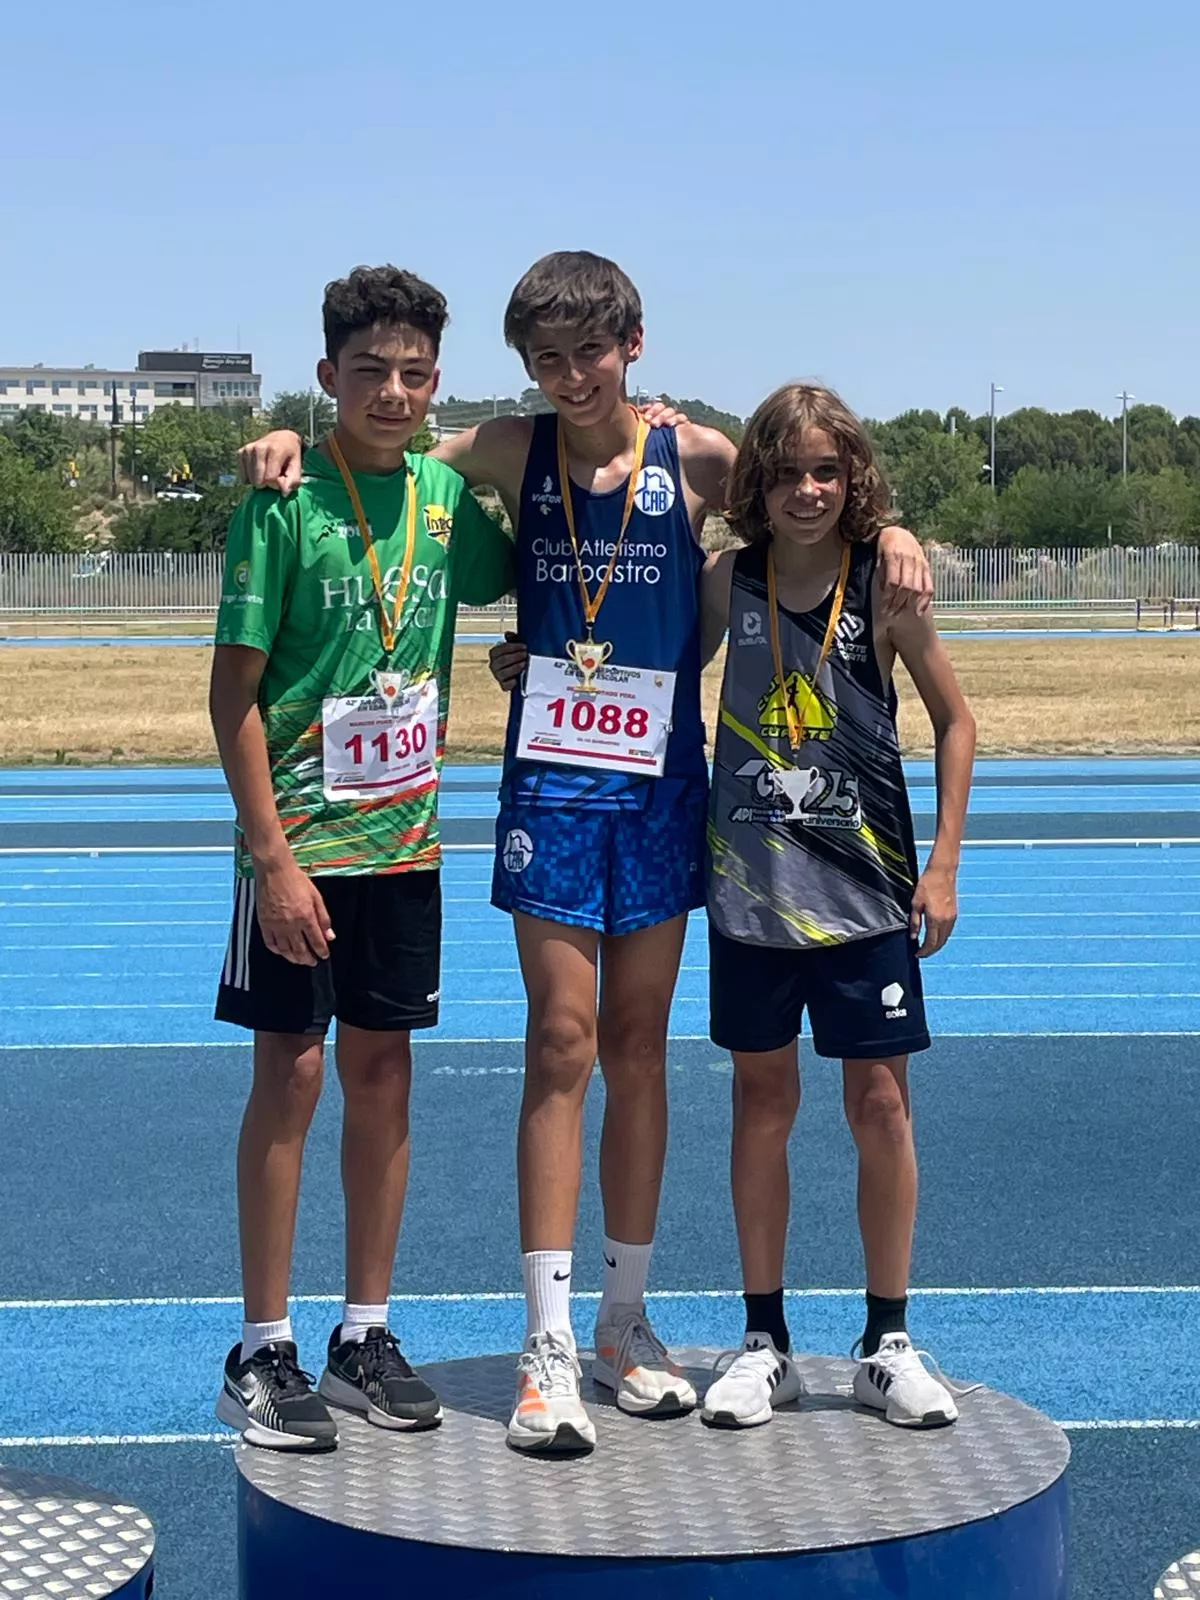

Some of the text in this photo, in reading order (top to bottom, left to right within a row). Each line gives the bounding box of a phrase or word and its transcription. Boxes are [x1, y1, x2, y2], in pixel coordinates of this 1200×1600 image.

[642, 490, 668, 512] CAB
[532, 538, 667, 558] Club Atletismo
[536, 559, 662, 584] Barbastro
[546, 696, 649, 740] 1088
[343, 722, 428, 765] 1130
